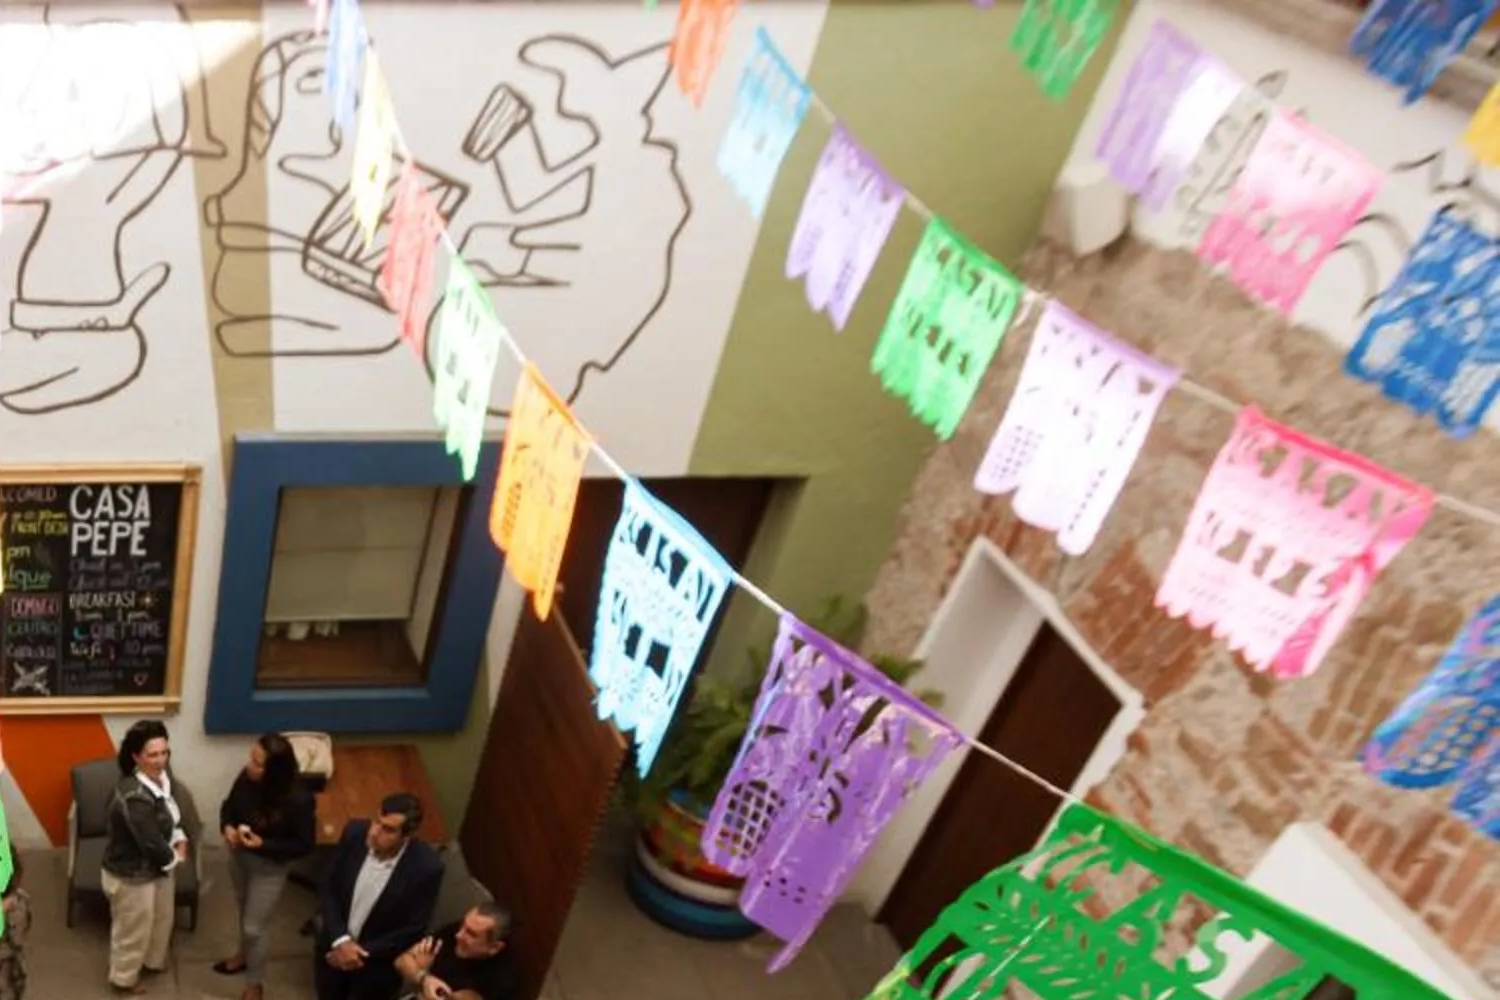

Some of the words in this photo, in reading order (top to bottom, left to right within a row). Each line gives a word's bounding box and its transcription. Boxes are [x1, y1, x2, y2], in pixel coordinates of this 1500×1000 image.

[69, 485, 151, 521] CASA
[71, 520, 152, 557] PEPE
[68, 591, 137, 610] BREAKFAST
